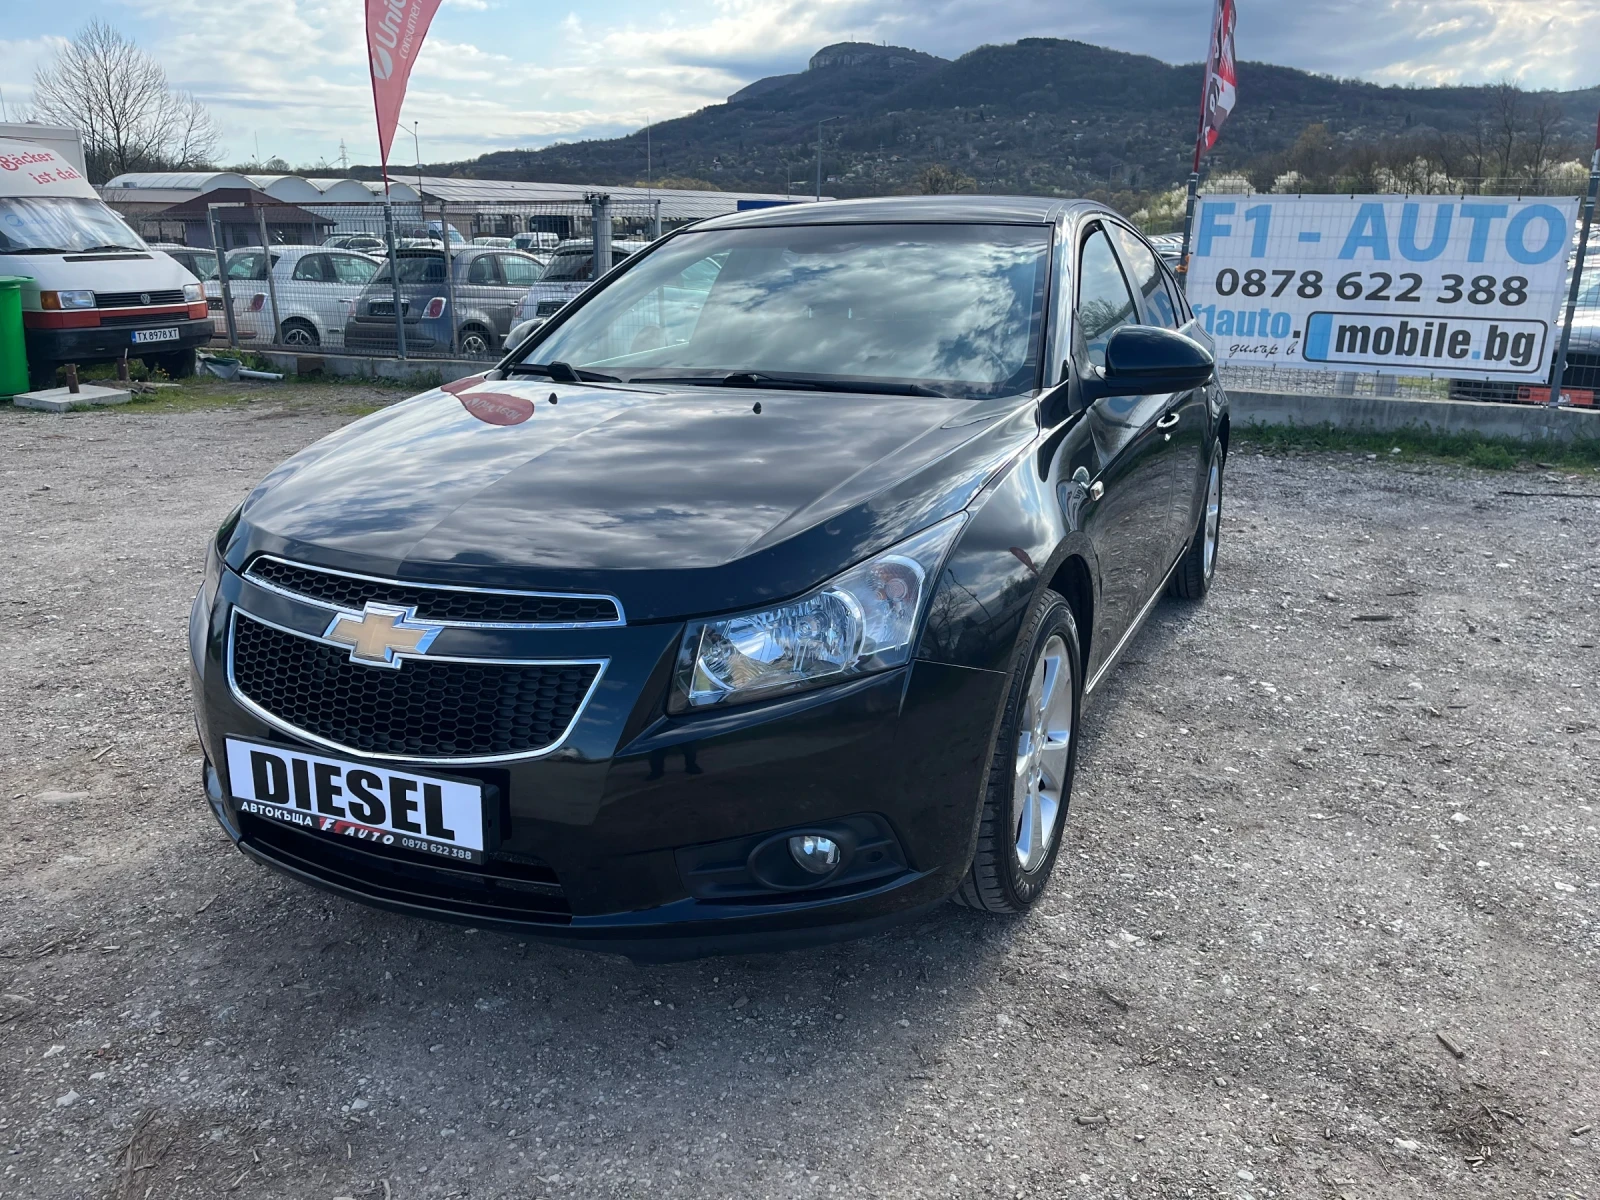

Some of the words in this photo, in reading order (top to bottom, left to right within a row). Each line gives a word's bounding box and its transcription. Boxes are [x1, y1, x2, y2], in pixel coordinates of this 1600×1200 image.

[398, 1, 421, 59] consumer
[0, 152, 55, 171] Bäcker
[28, 171, 57, 185] ist
[55, 166, 82, 180] da!
[1196, 202, 1272, 258] F1
[1338, 203, 1567, 265] AUTO
[1215, 268, 1323, 299] 0878
[1336, 271, 1423, 302] 622
[1436, 274, 1529, 306] 388
[1335, 320, 1536, 367] mobile.bg
[249, 750, 455, 842] DIESEL
[241, 801, 313, 827] АВТОКЪЩА
[344, 826, 394, 845] AUTO
[401, 837, 428, 851] 0878
[430, 843, 449, 856] 622
[451, 848, 472, 860] 388
